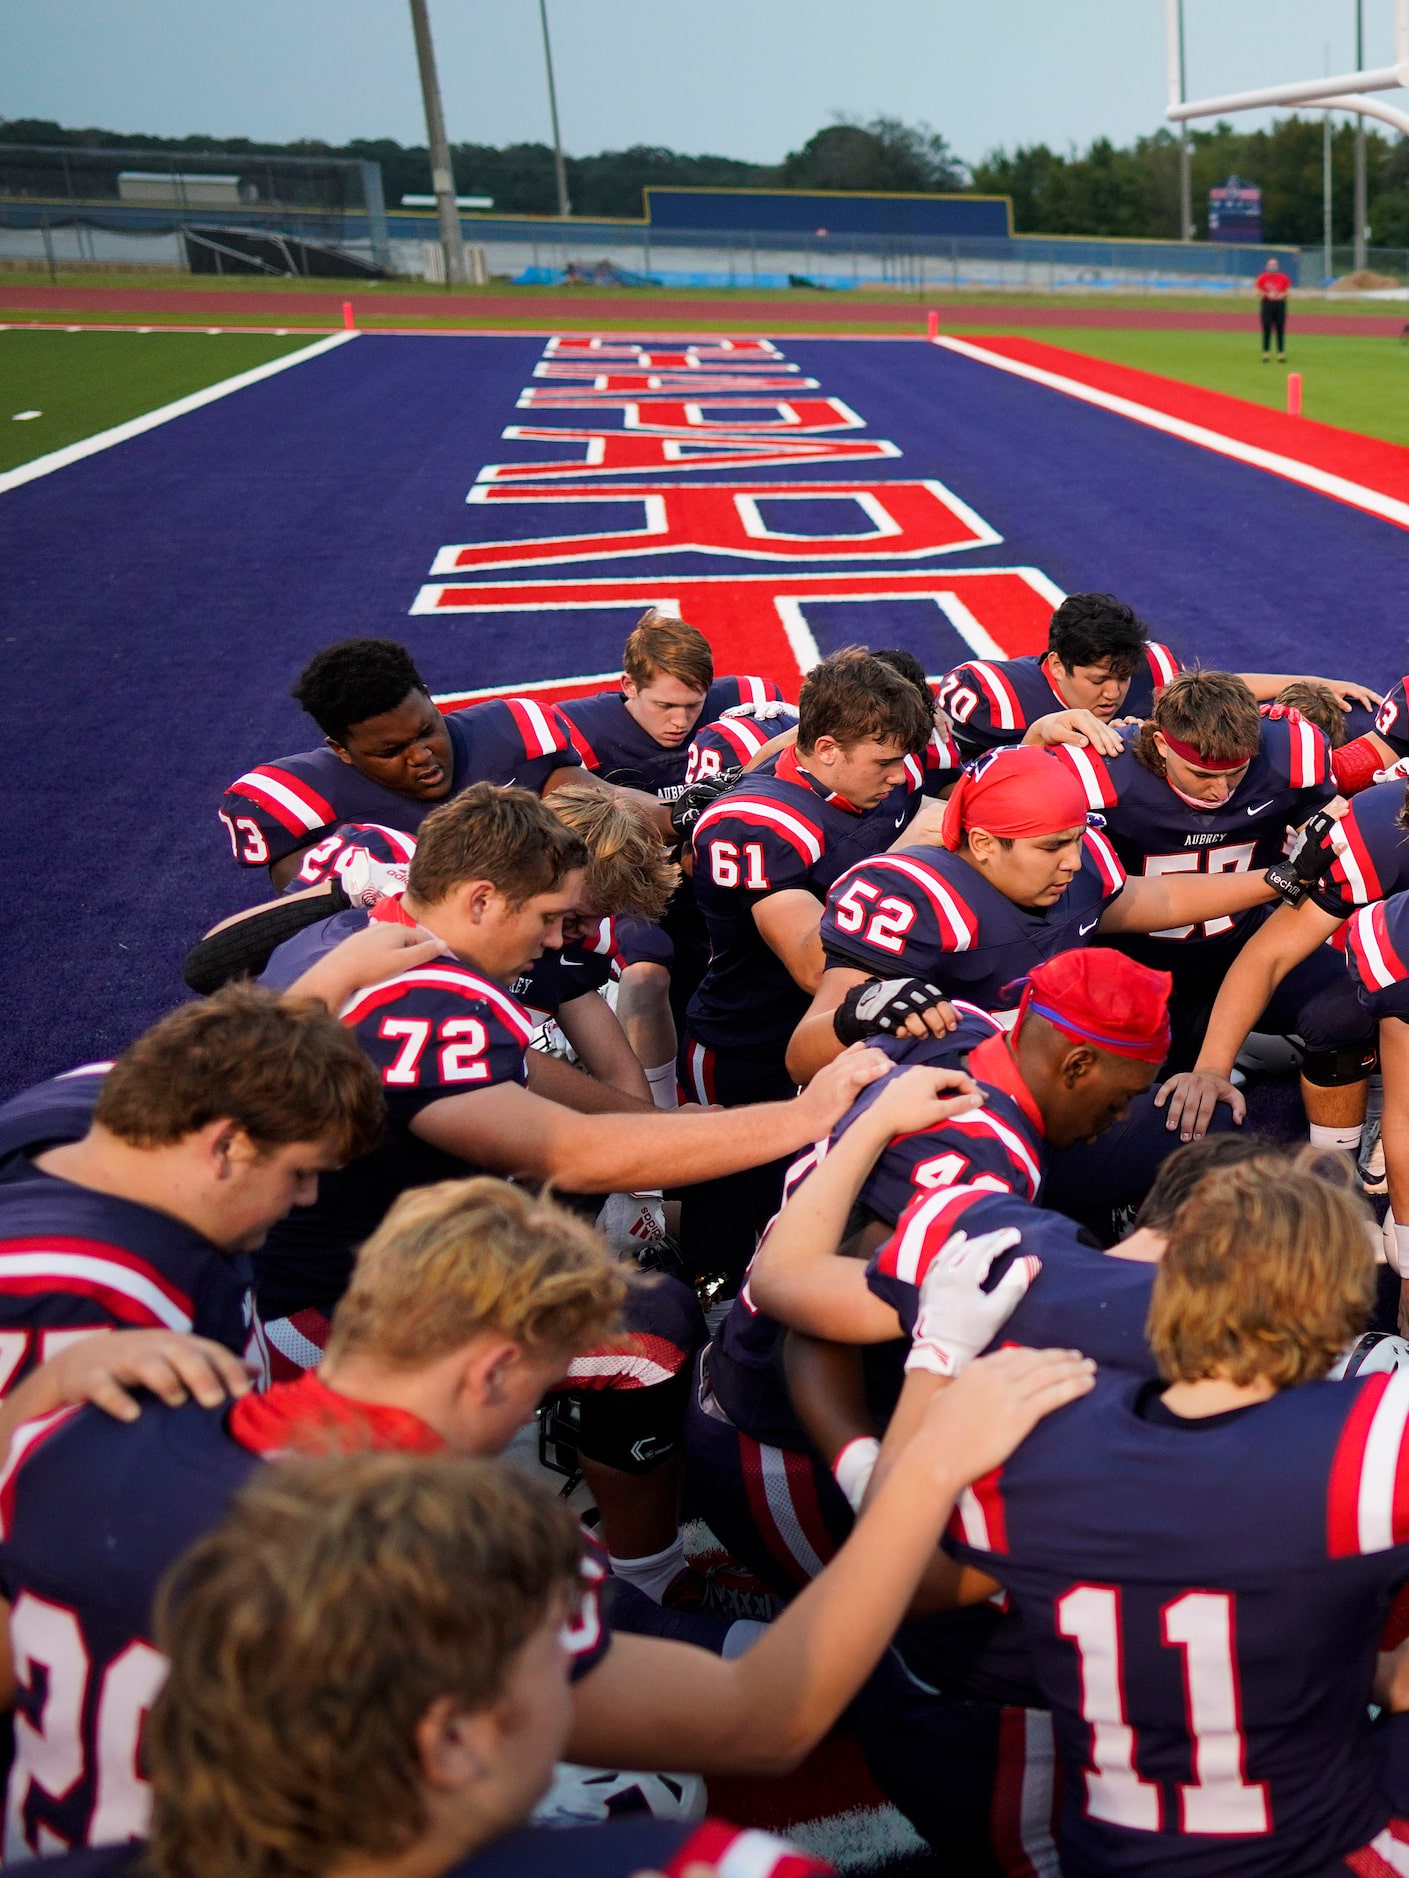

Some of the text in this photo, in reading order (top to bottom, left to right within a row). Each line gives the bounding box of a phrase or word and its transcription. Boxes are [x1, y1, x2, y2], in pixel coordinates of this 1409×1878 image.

[937, 672, 980, 725] 70
[1375, 690, 1399, 737] 3
[686, 741, 723, 784] 28
[708, 838, 771, 890] 61
[1183, 832, 1228, 847] AUBREY
[1270, 872, 1301, 896] techfit
[835, 877, 918, 955] 52
[378, 1015, 492, 1087] 72
[1054, 1582, 1276, 1837] 11
